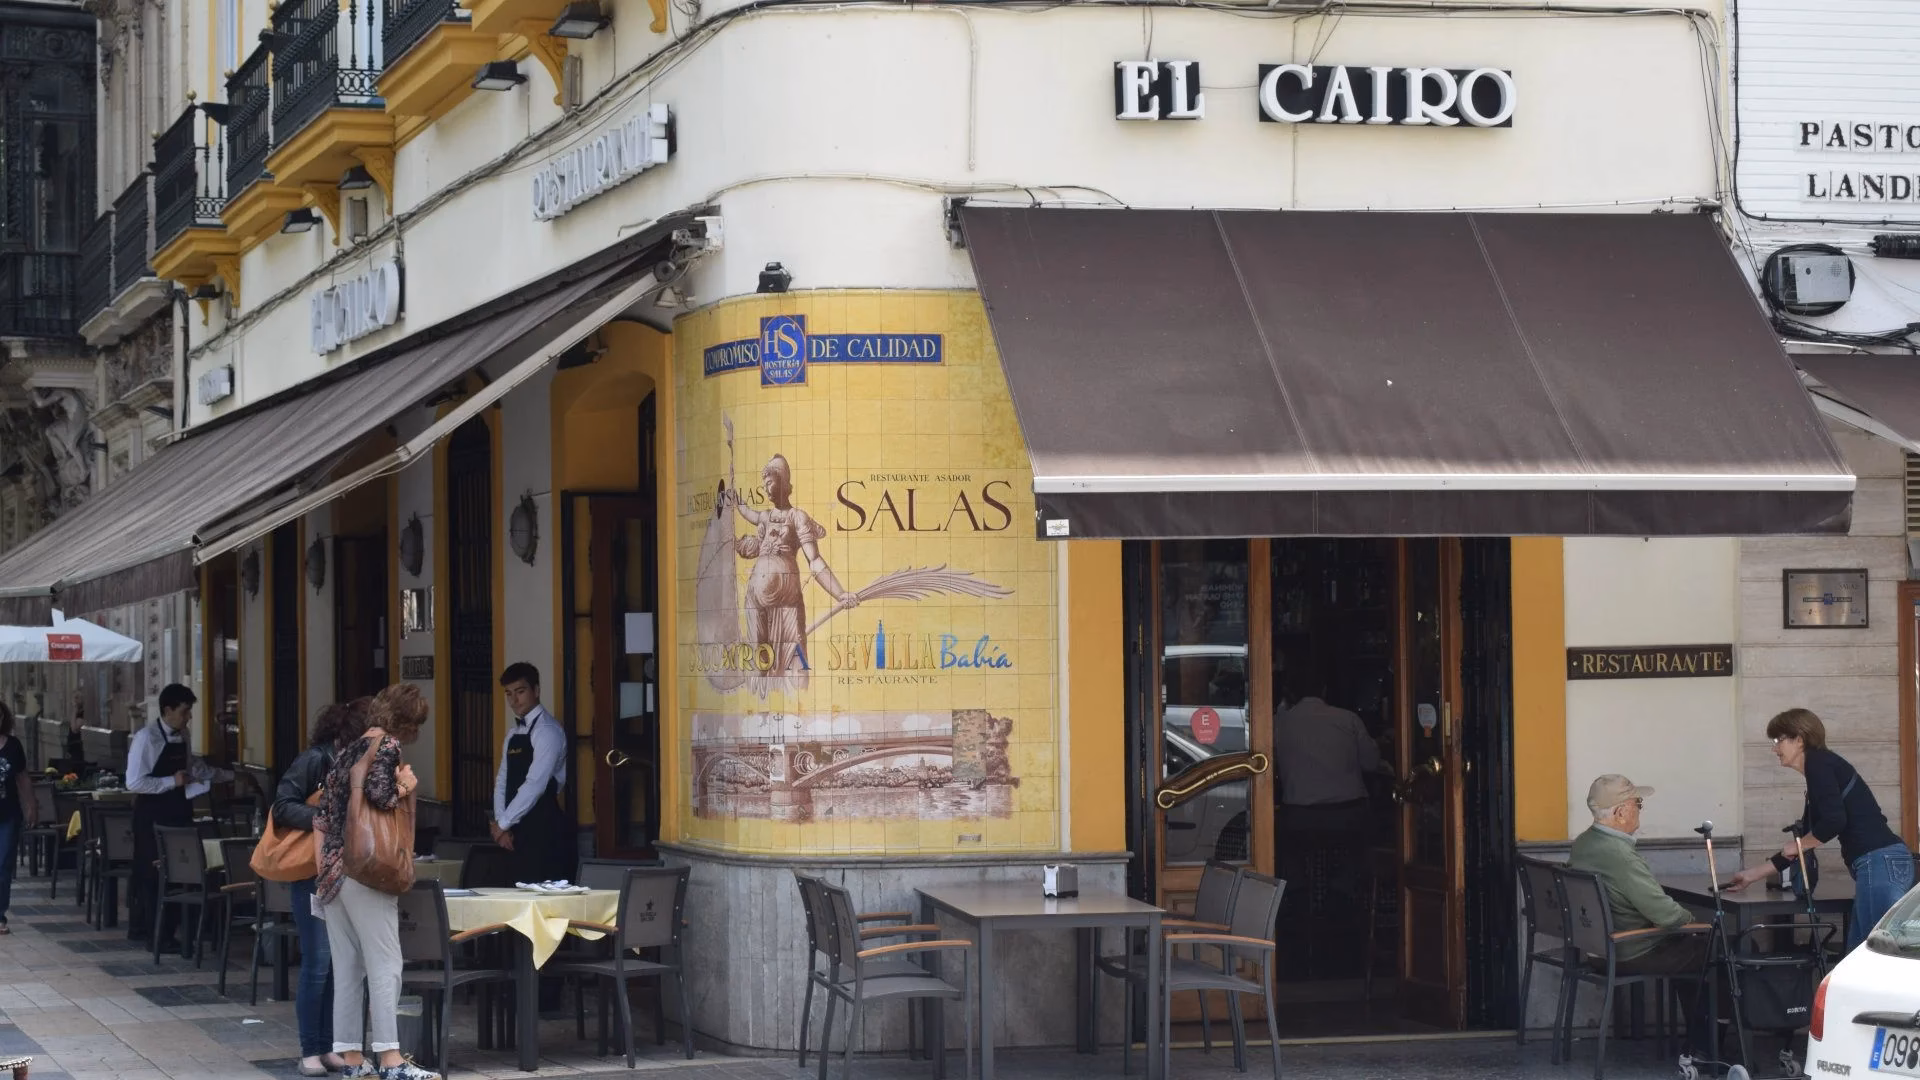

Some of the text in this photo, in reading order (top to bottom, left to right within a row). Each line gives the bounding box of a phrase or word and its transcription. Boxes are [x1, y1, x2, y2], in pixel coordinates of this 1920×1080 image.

[1117, 58, 1517, 127] EL CAIRO
[1807, 174, 1920, 199] LAND
[763, 323, 799, 360] HS
[705, 338, 936, 371] COMPROMISO DE CALIDAD
[769, 370, 793, 378] SALAS
[870, 474, 972, 482] RESTAURANTE ASADOR
[725, 486, 765, 508] SALAS
[836, 480, 1013, 532] SALAS
[828, 626, 936, 671] SEVILLA
[1582, 651, 1725, 674] RESTAURANTE
[837, 675, 938, 686] RESTAURANTE
[1816, 1059, 1852, 1077] PEUGEOT
